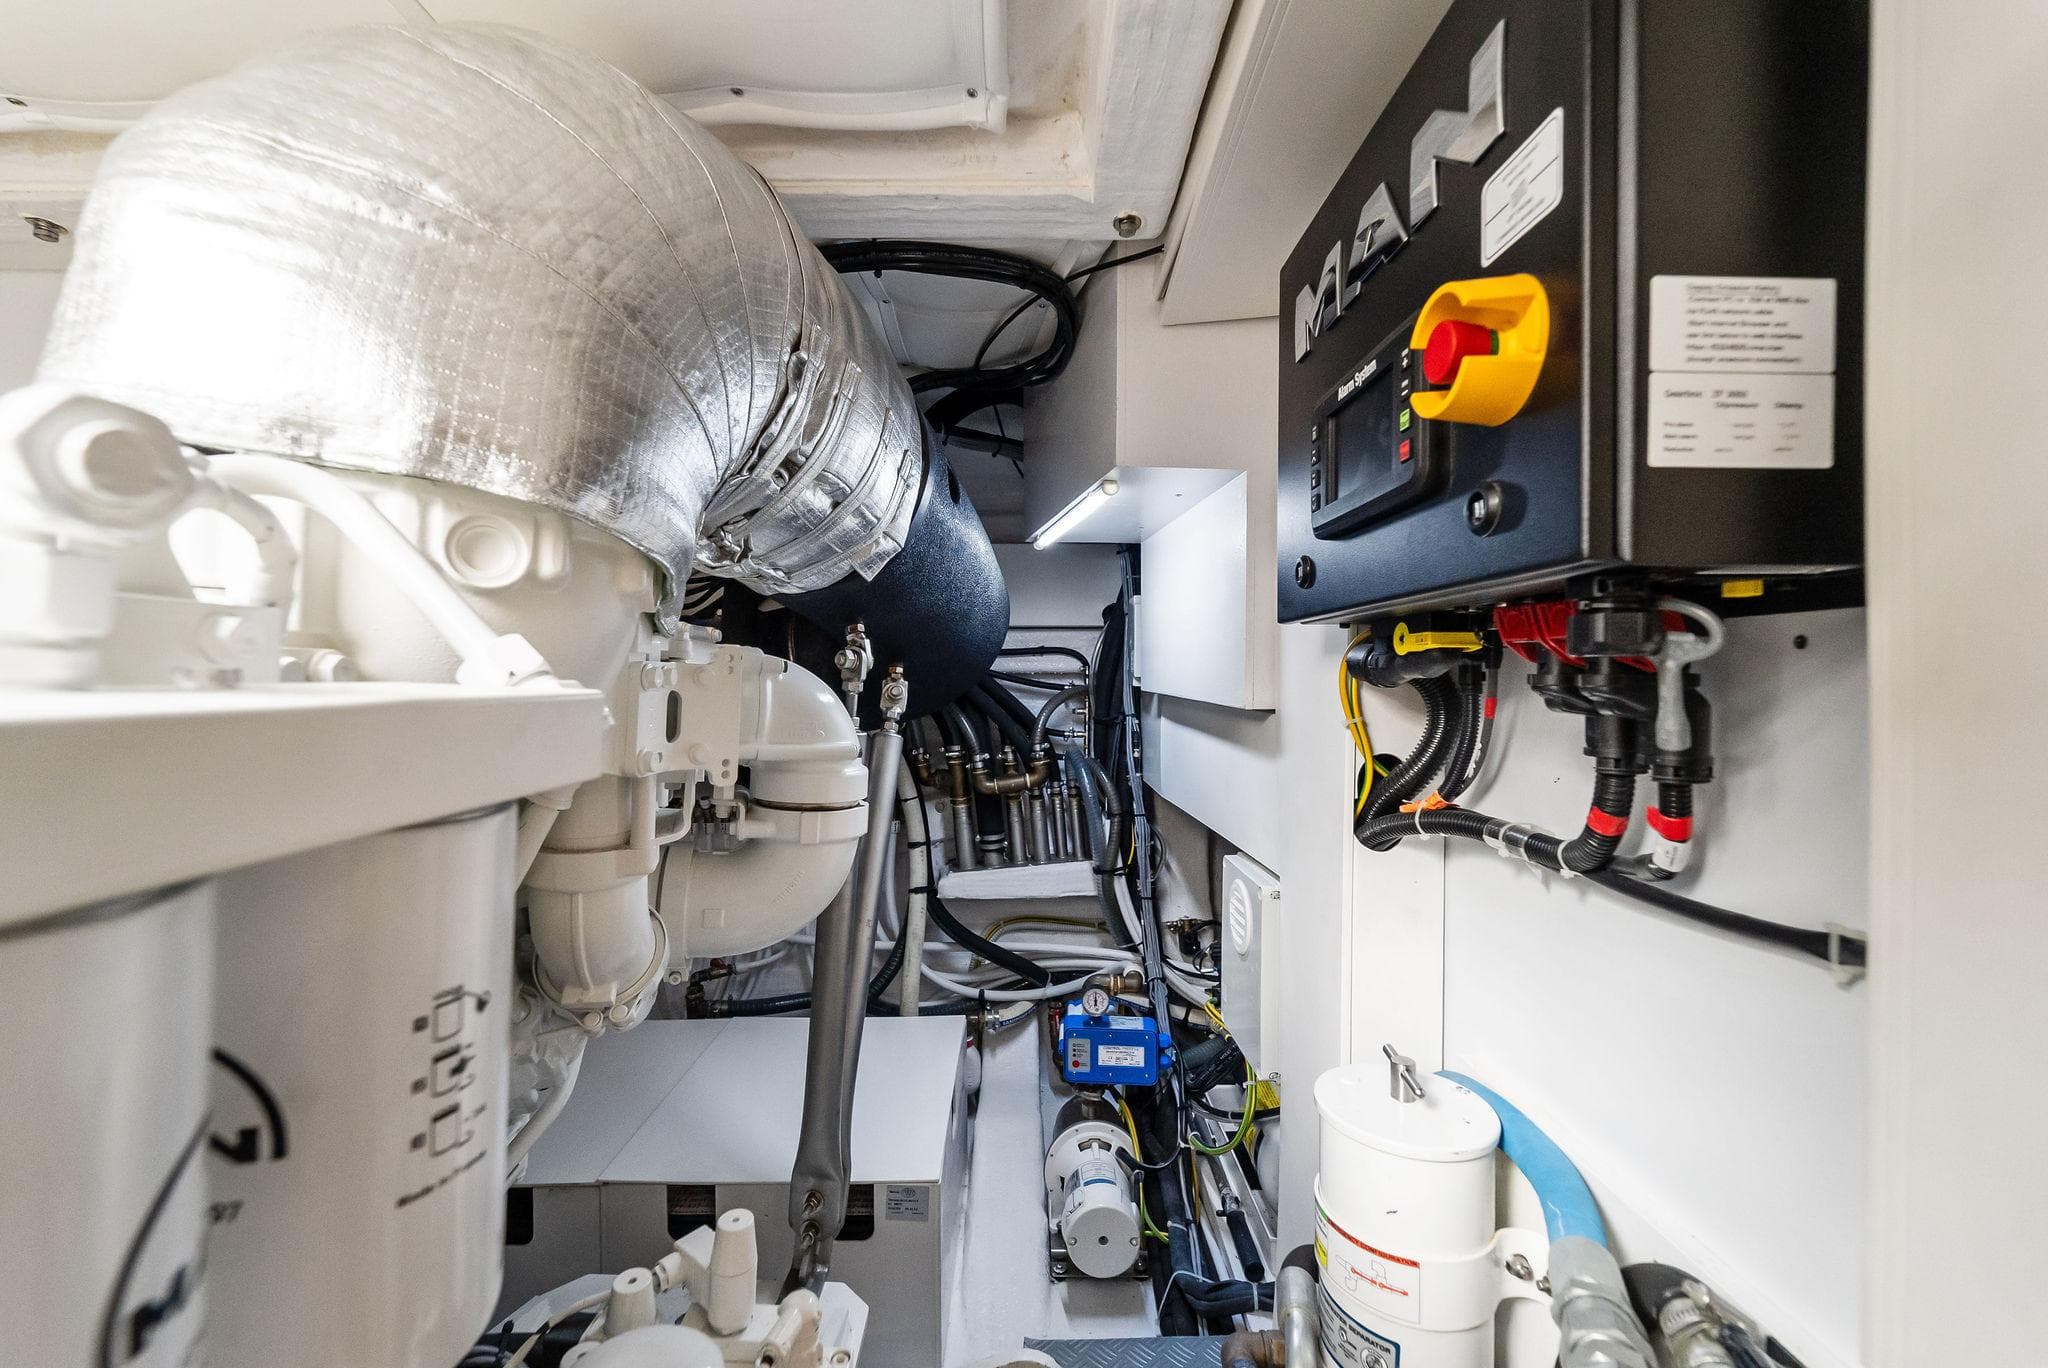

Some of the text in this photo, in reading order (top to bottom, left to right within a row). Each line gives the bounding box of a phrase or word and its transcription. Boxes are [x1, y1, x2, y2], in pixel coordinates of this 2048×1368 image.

[1295, 19, 1507, 363] MAN
[1338, 359, 1377, 402] Alarm System
